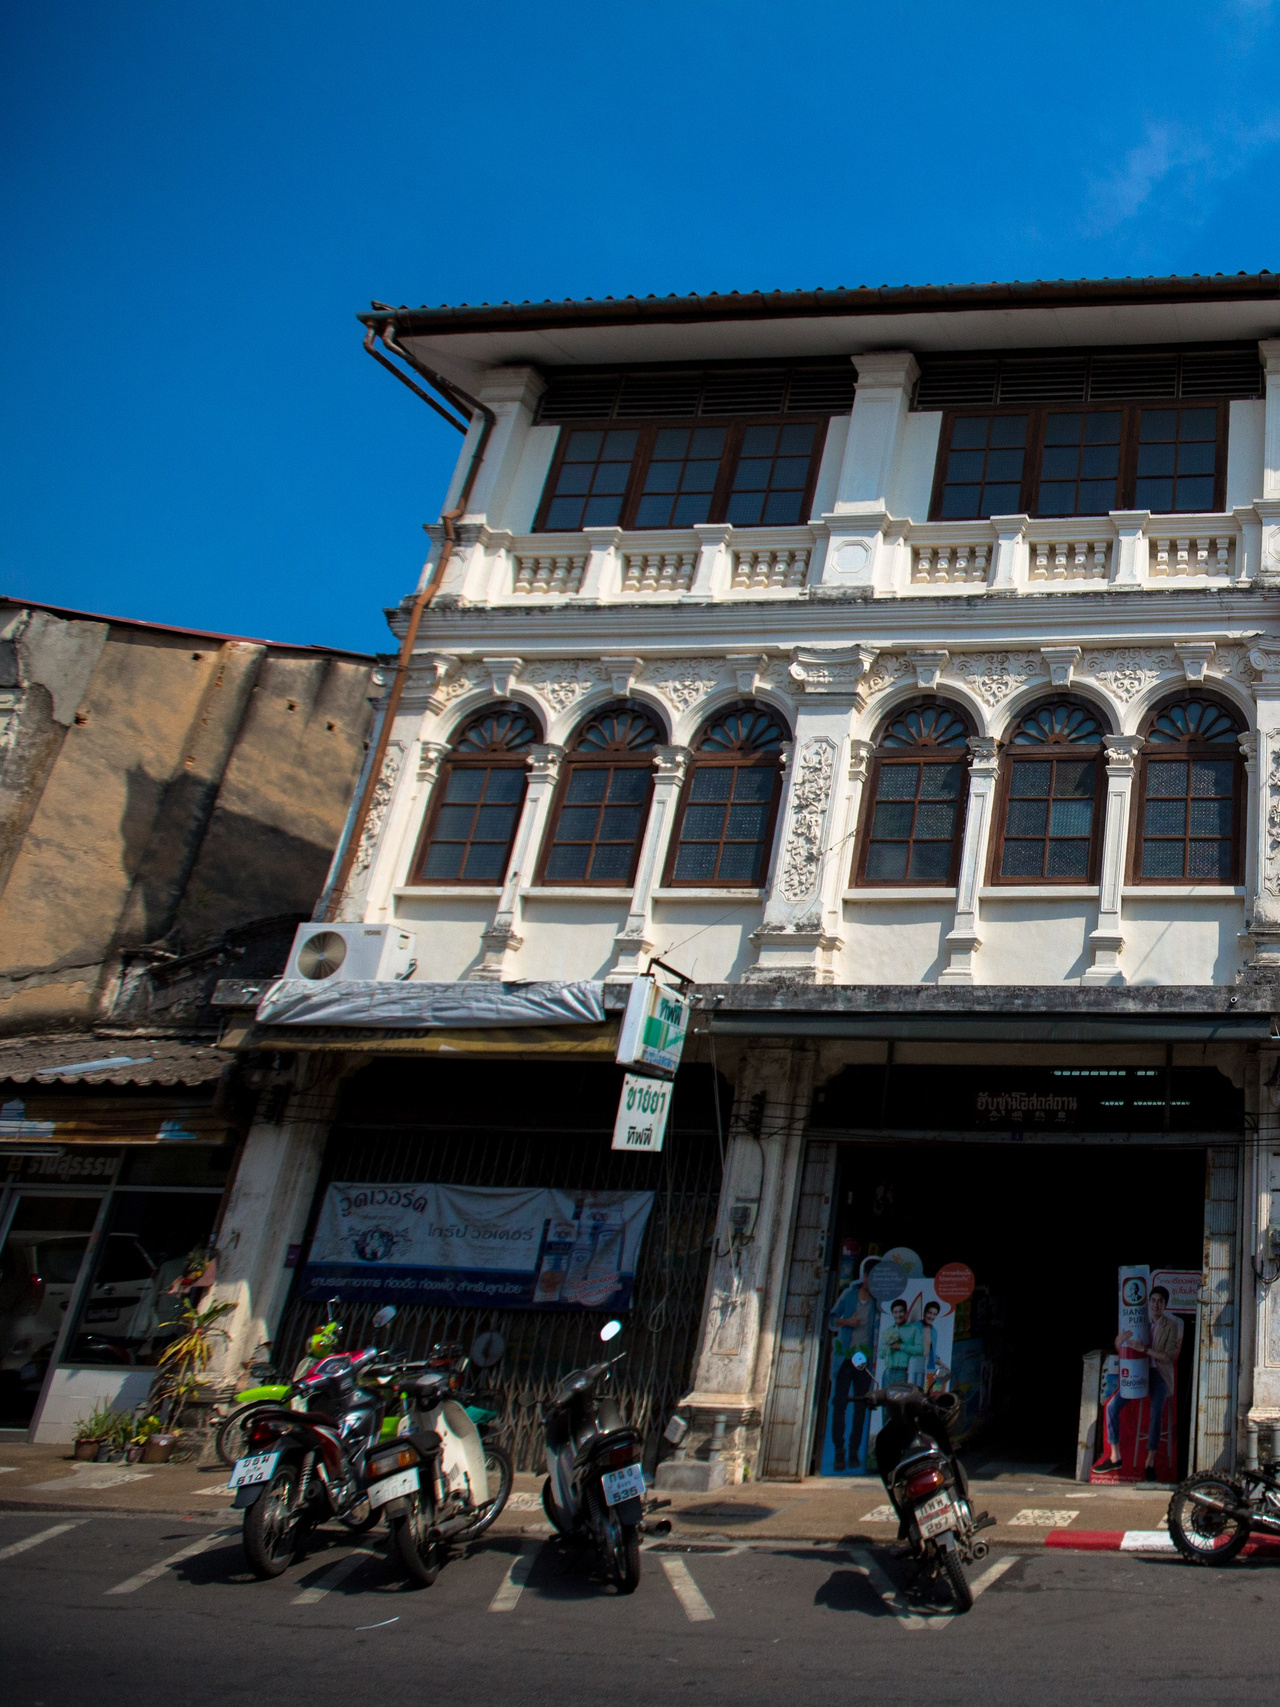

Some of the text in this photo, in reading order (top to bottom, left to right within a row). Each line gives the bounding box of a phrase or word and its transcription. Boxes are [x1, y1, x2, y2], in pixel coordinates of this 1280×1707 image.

[626, 1124, 653, 1146] ทิฟฟี่
[340, 1189, 428, 1217] วูดเวอร์ด
[236, 1472, 264, 1485] 614
[613, 1485, 638, 1502] 535
